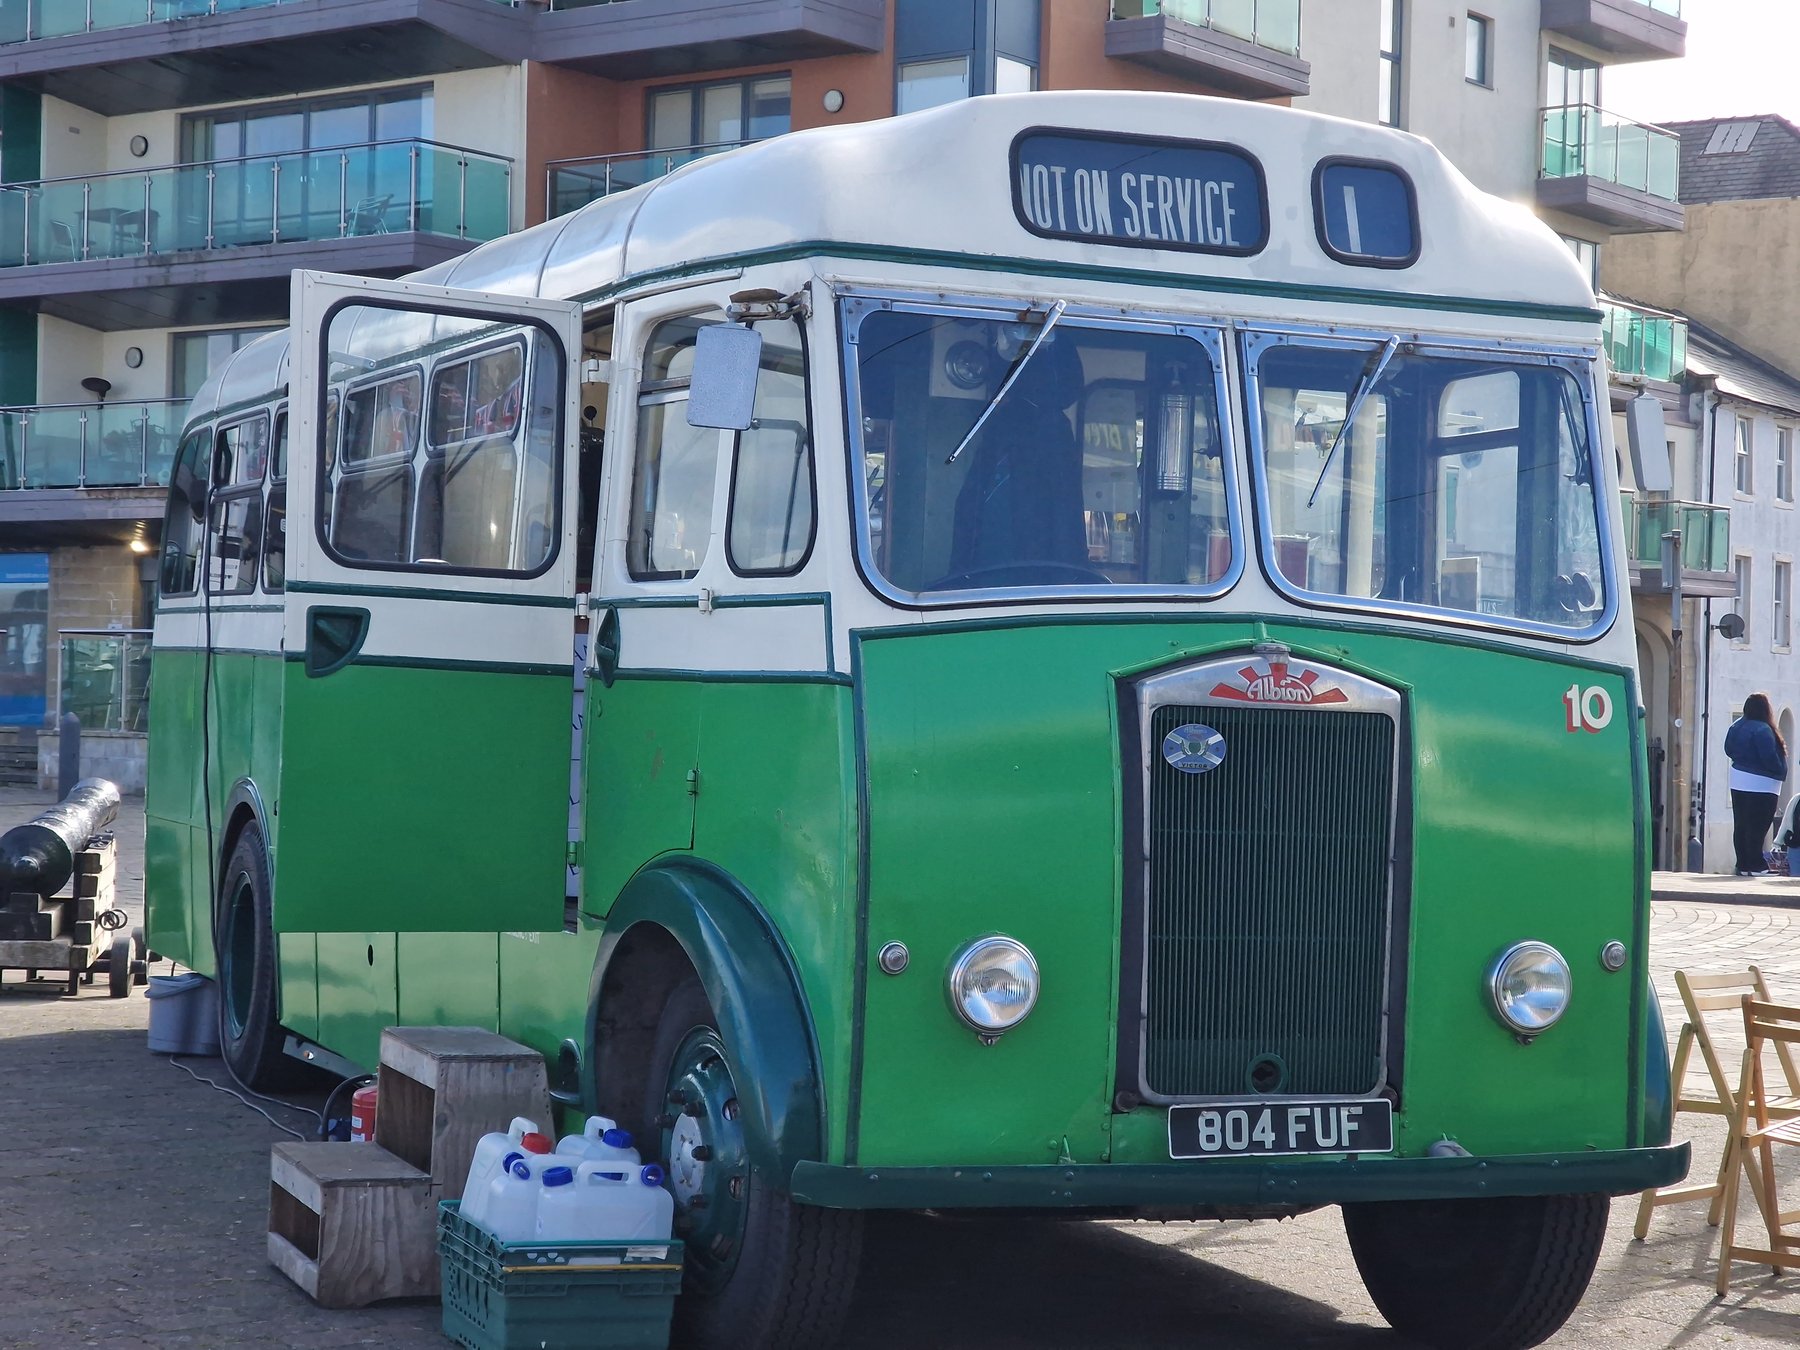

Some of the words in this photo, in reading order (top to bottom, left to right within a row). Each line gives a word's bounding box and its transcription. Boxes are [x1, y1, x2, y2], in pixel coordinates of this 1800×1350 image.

[1074, 168, 1113, 235] ON
[1121, 172, 1240, 246] SERVICE
[1247, 676, 1313, 703] Albion
[1562, 684, 1613, 733] 10
[1198, 1109, 1276, 1152] 804
[1287, 1106, 1363, 1149] FUF
